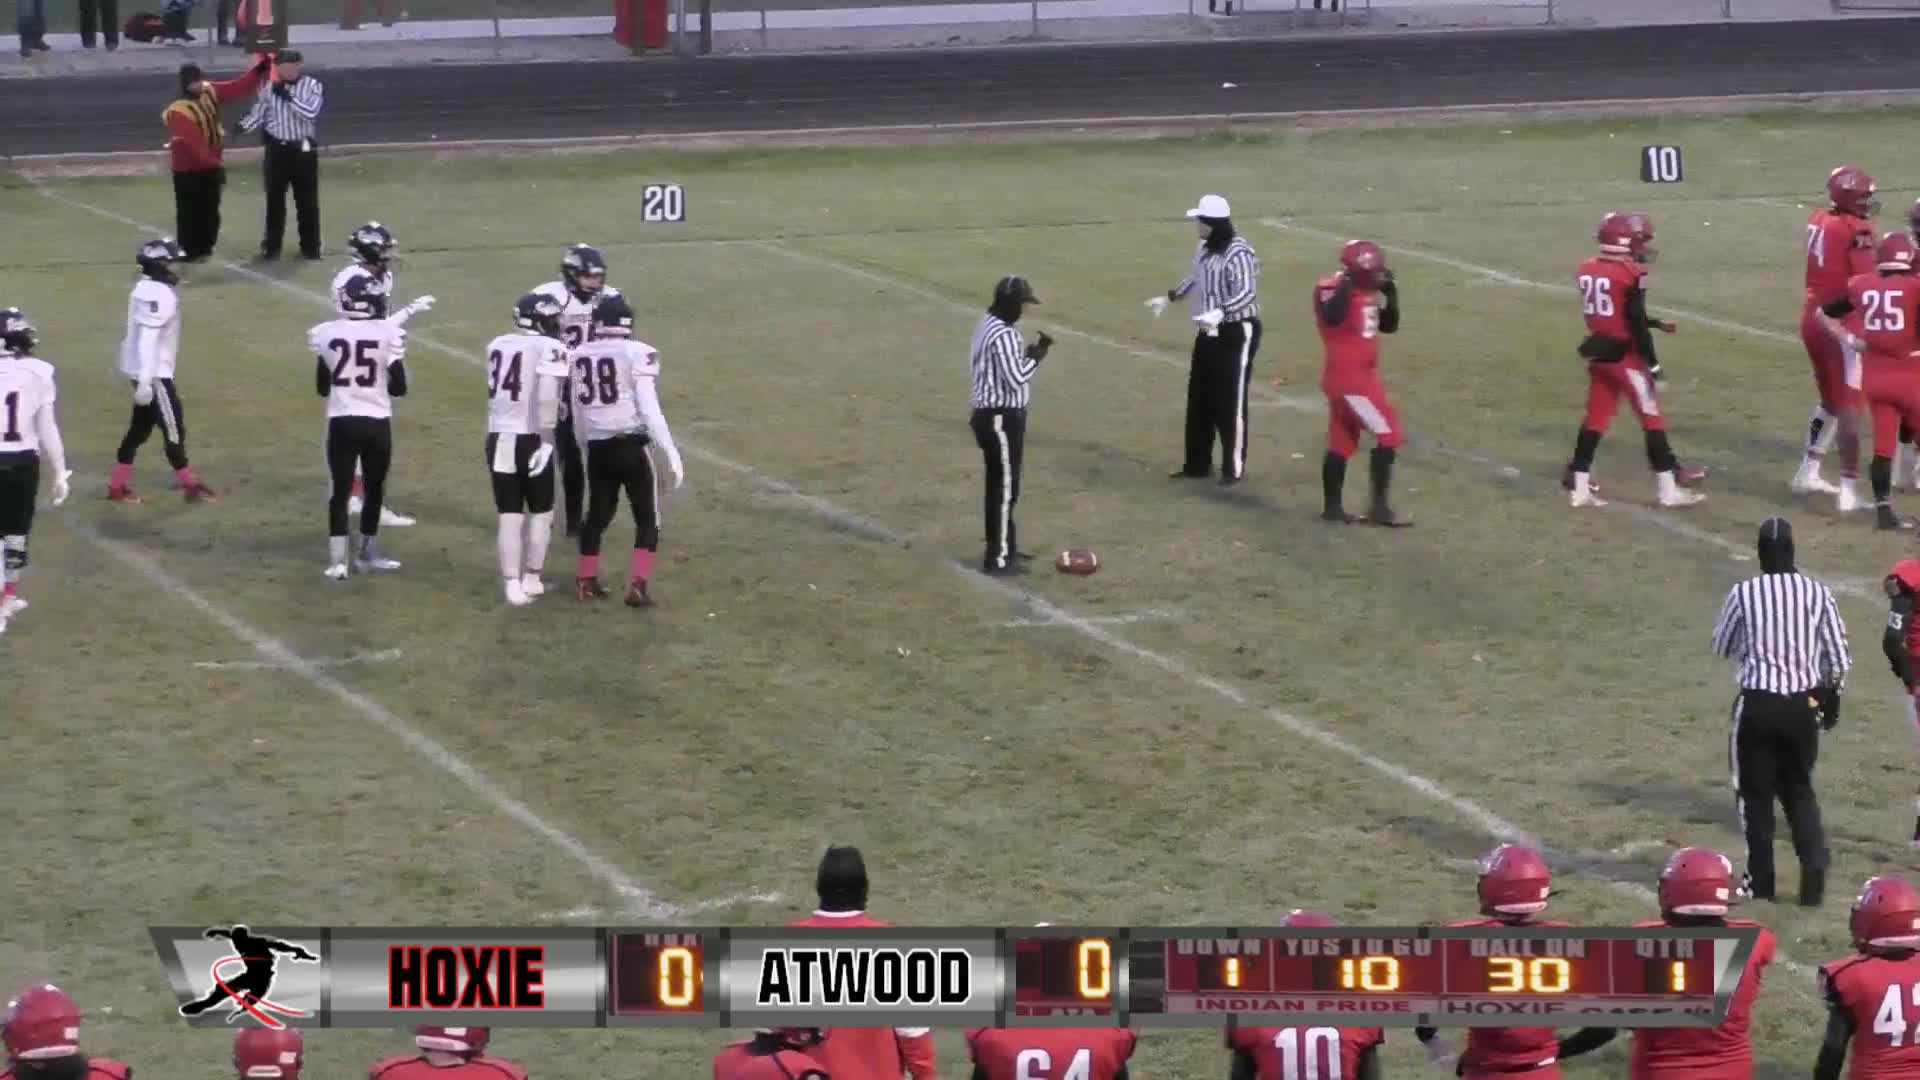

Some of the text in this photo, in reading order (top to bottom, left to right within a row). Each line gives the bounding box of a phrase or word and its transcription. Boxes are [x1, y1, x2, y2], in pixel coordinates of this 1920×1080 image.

[1648, 146, 1678, 181] 10
[644, 185, 682, 221] 20
[1579, 275, 1614, 316] 26
[1862, 289, 1905, 331] 25
[328, 338, 378, 387] 25
[489, 349, 523, 401] 34
[576, 356, 619, 405] 38
[1873, 982, 1920, 1047] 4
[1274, 1027, 1341, 1080] 10
